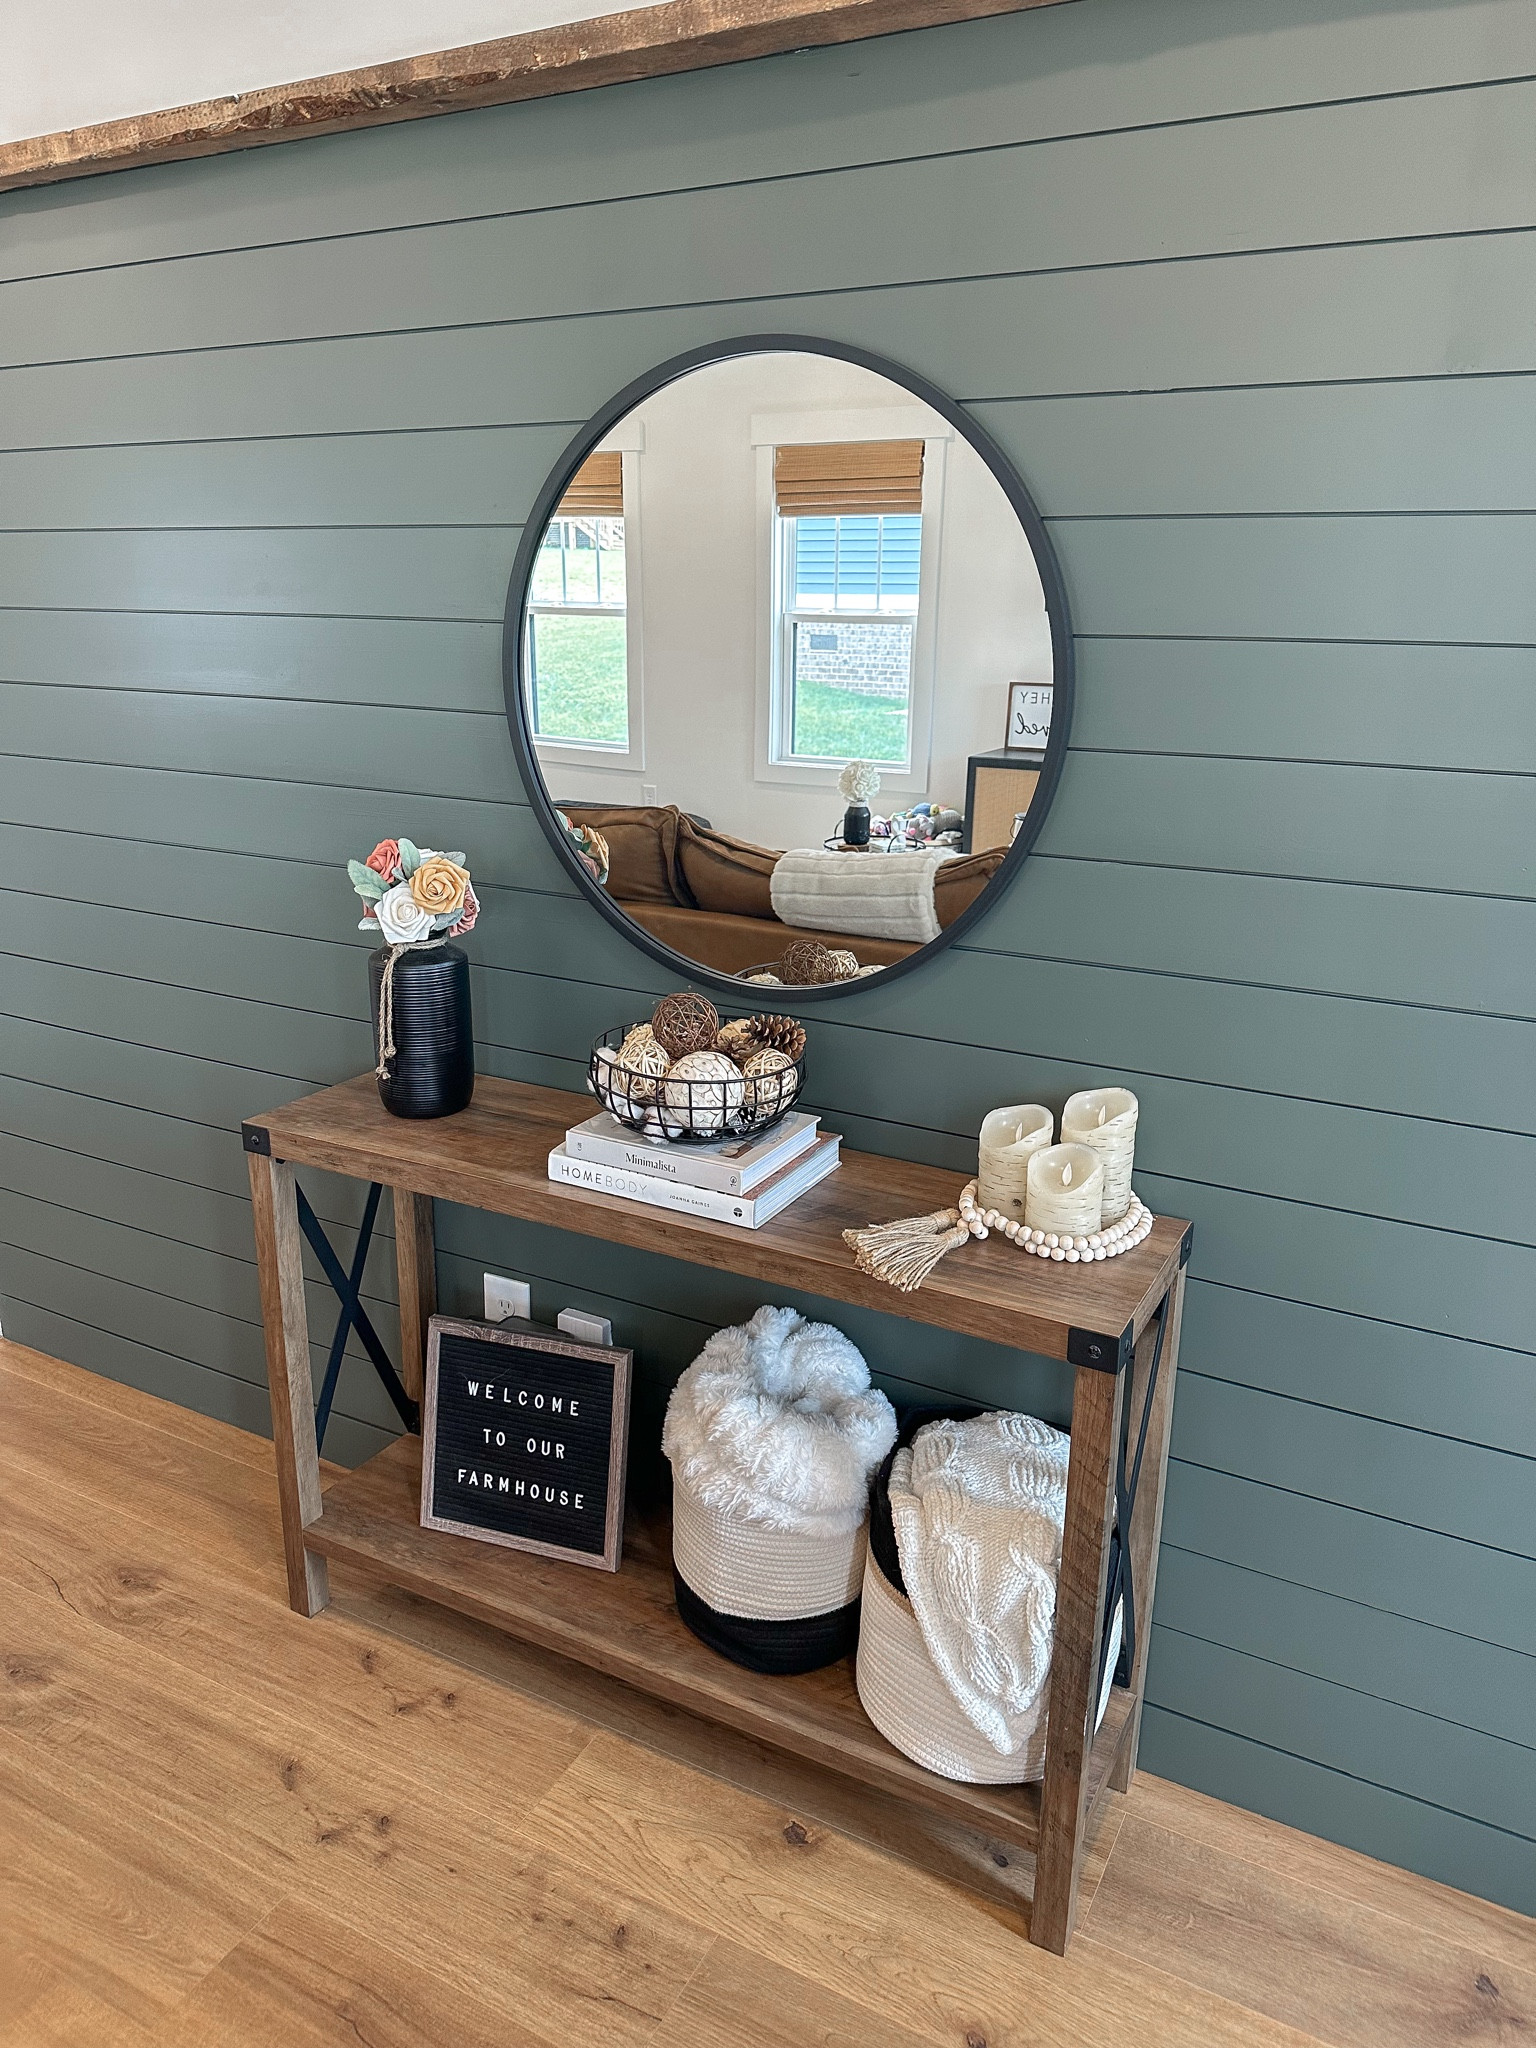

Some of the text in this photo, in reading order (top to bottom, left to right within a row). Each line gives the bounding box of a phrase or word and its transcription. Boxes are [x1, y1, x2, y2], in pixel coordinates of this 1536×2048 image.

[625, 1152, 677, 1174] Minimalista
[561, 1164, 710, 1208] HOMEBODY JOANNA GAINES
[467, 1380, 580, 1417] WELCOME
[482, 1428, 565, 1460] TO OUR
[457, 1468, 584, 1510] FARMHOUSE
